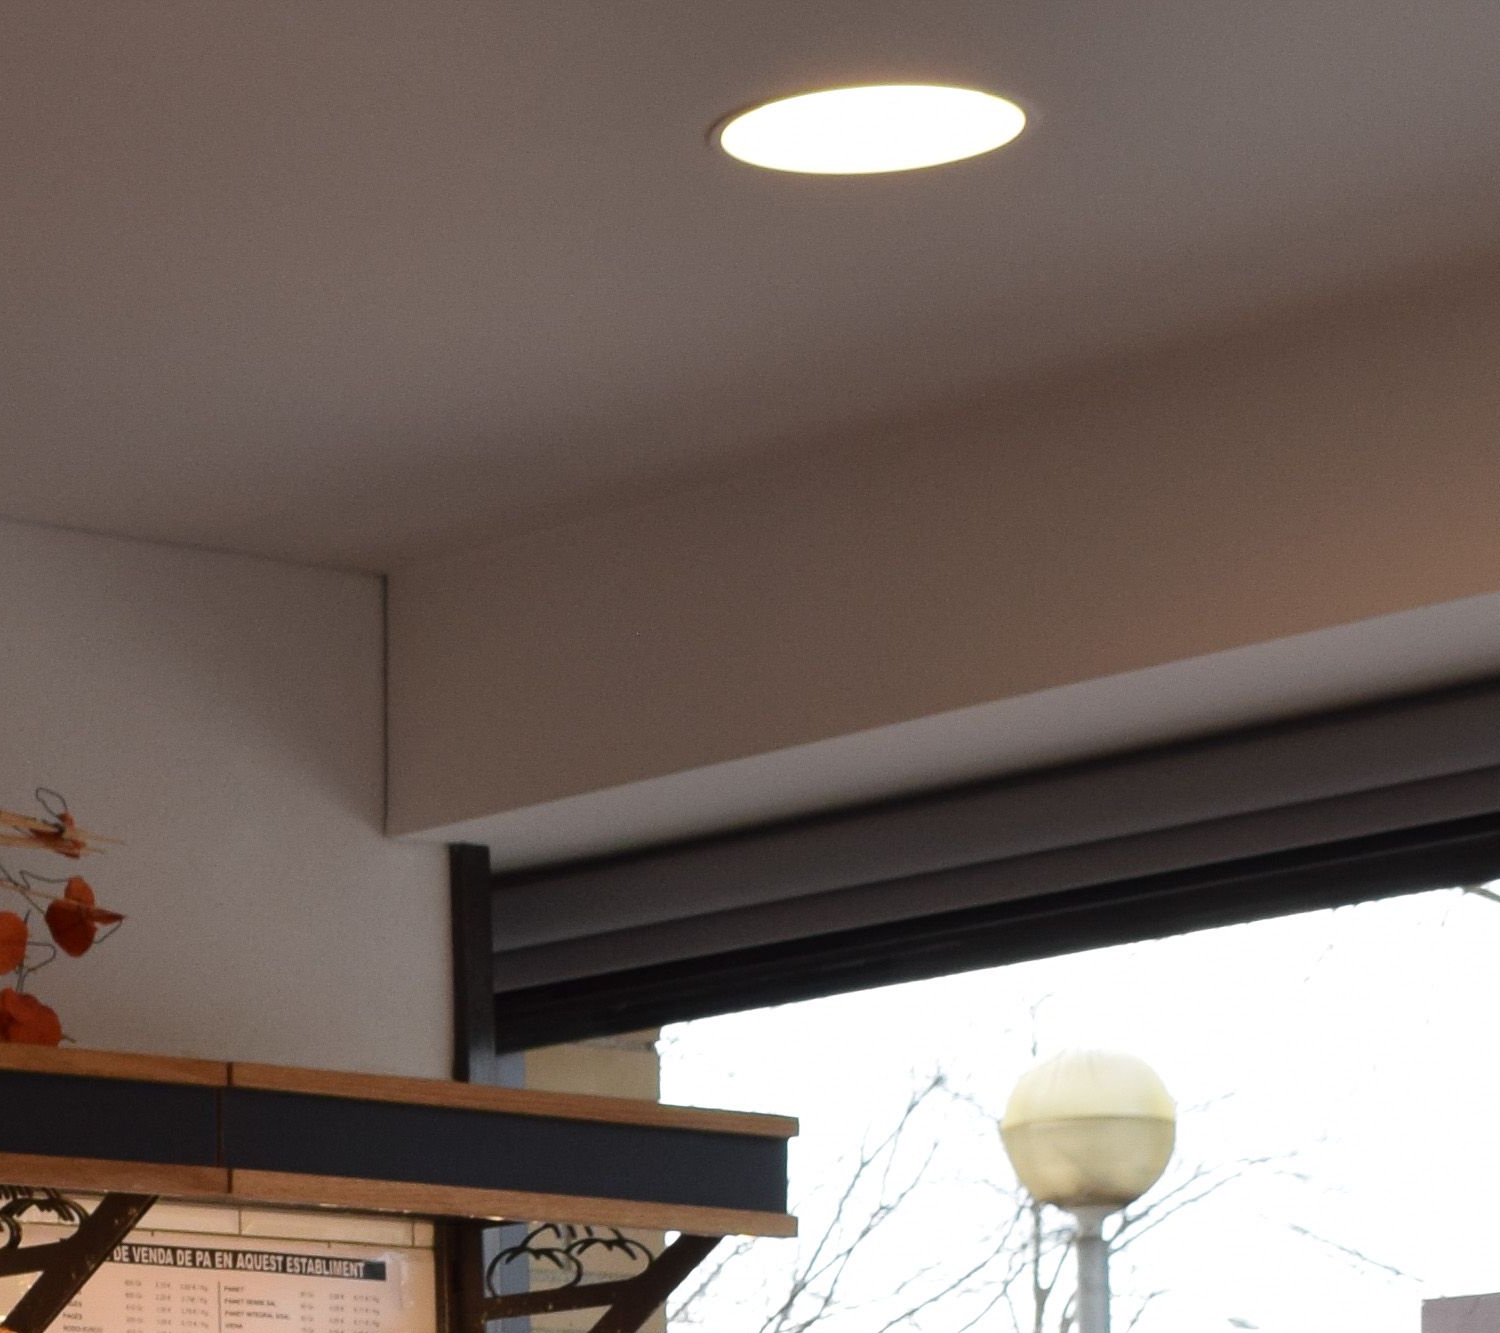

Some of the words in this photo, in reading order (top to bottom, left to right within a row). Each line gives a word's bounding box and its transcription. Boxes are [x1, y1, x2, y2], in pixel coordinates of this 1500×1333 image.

[113, 1246, 129, 1262] DE
[132, 1247, 173, 1265] VENDA
[176, 1250, 193, 1265] DE
[196, 1250, 211, 1268] PA
[215, 1252, 233, 1269] EN
[236, 1253, 283, 1272] AQUEST
[286, 1256, 365, 1278] ESTABLIMENT
